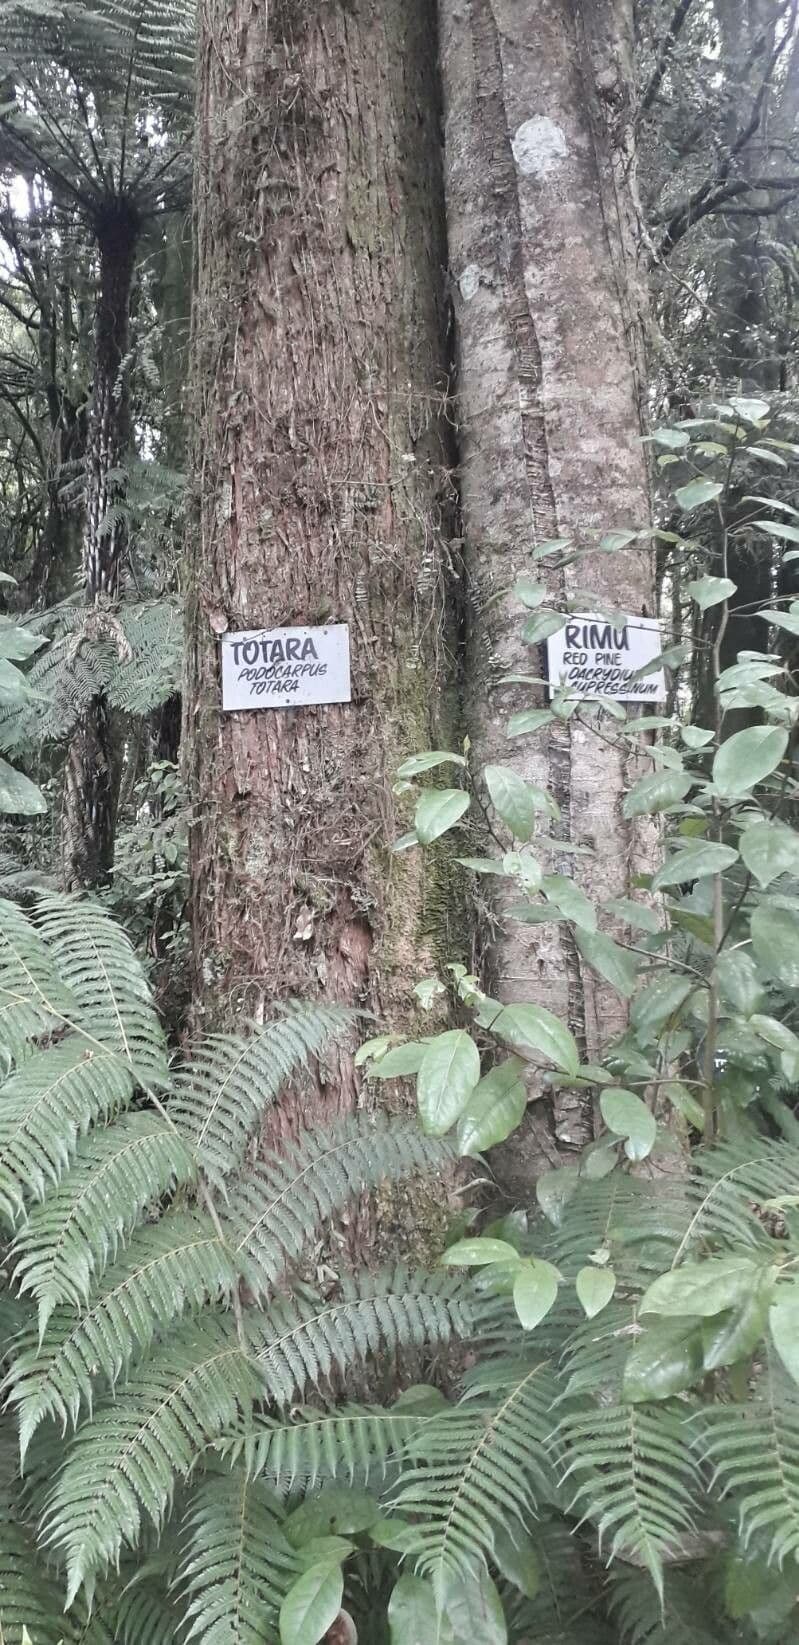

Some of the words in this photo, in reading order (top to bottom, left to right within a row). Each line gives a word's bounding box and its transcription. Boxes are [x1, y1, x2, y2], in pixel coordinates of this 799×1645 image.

[565, 625, 630, 650] RIMU
[230, 638, 319, 665] TOTARA
[563, 652, 588, 665] RED
[595, 652, 622, 666] PINE
[238, 664, 328, 681] PODOCARPUS
[568, 667, 635, 681] DACRYDIU
[250, 679, 300, 695] TOTARA
